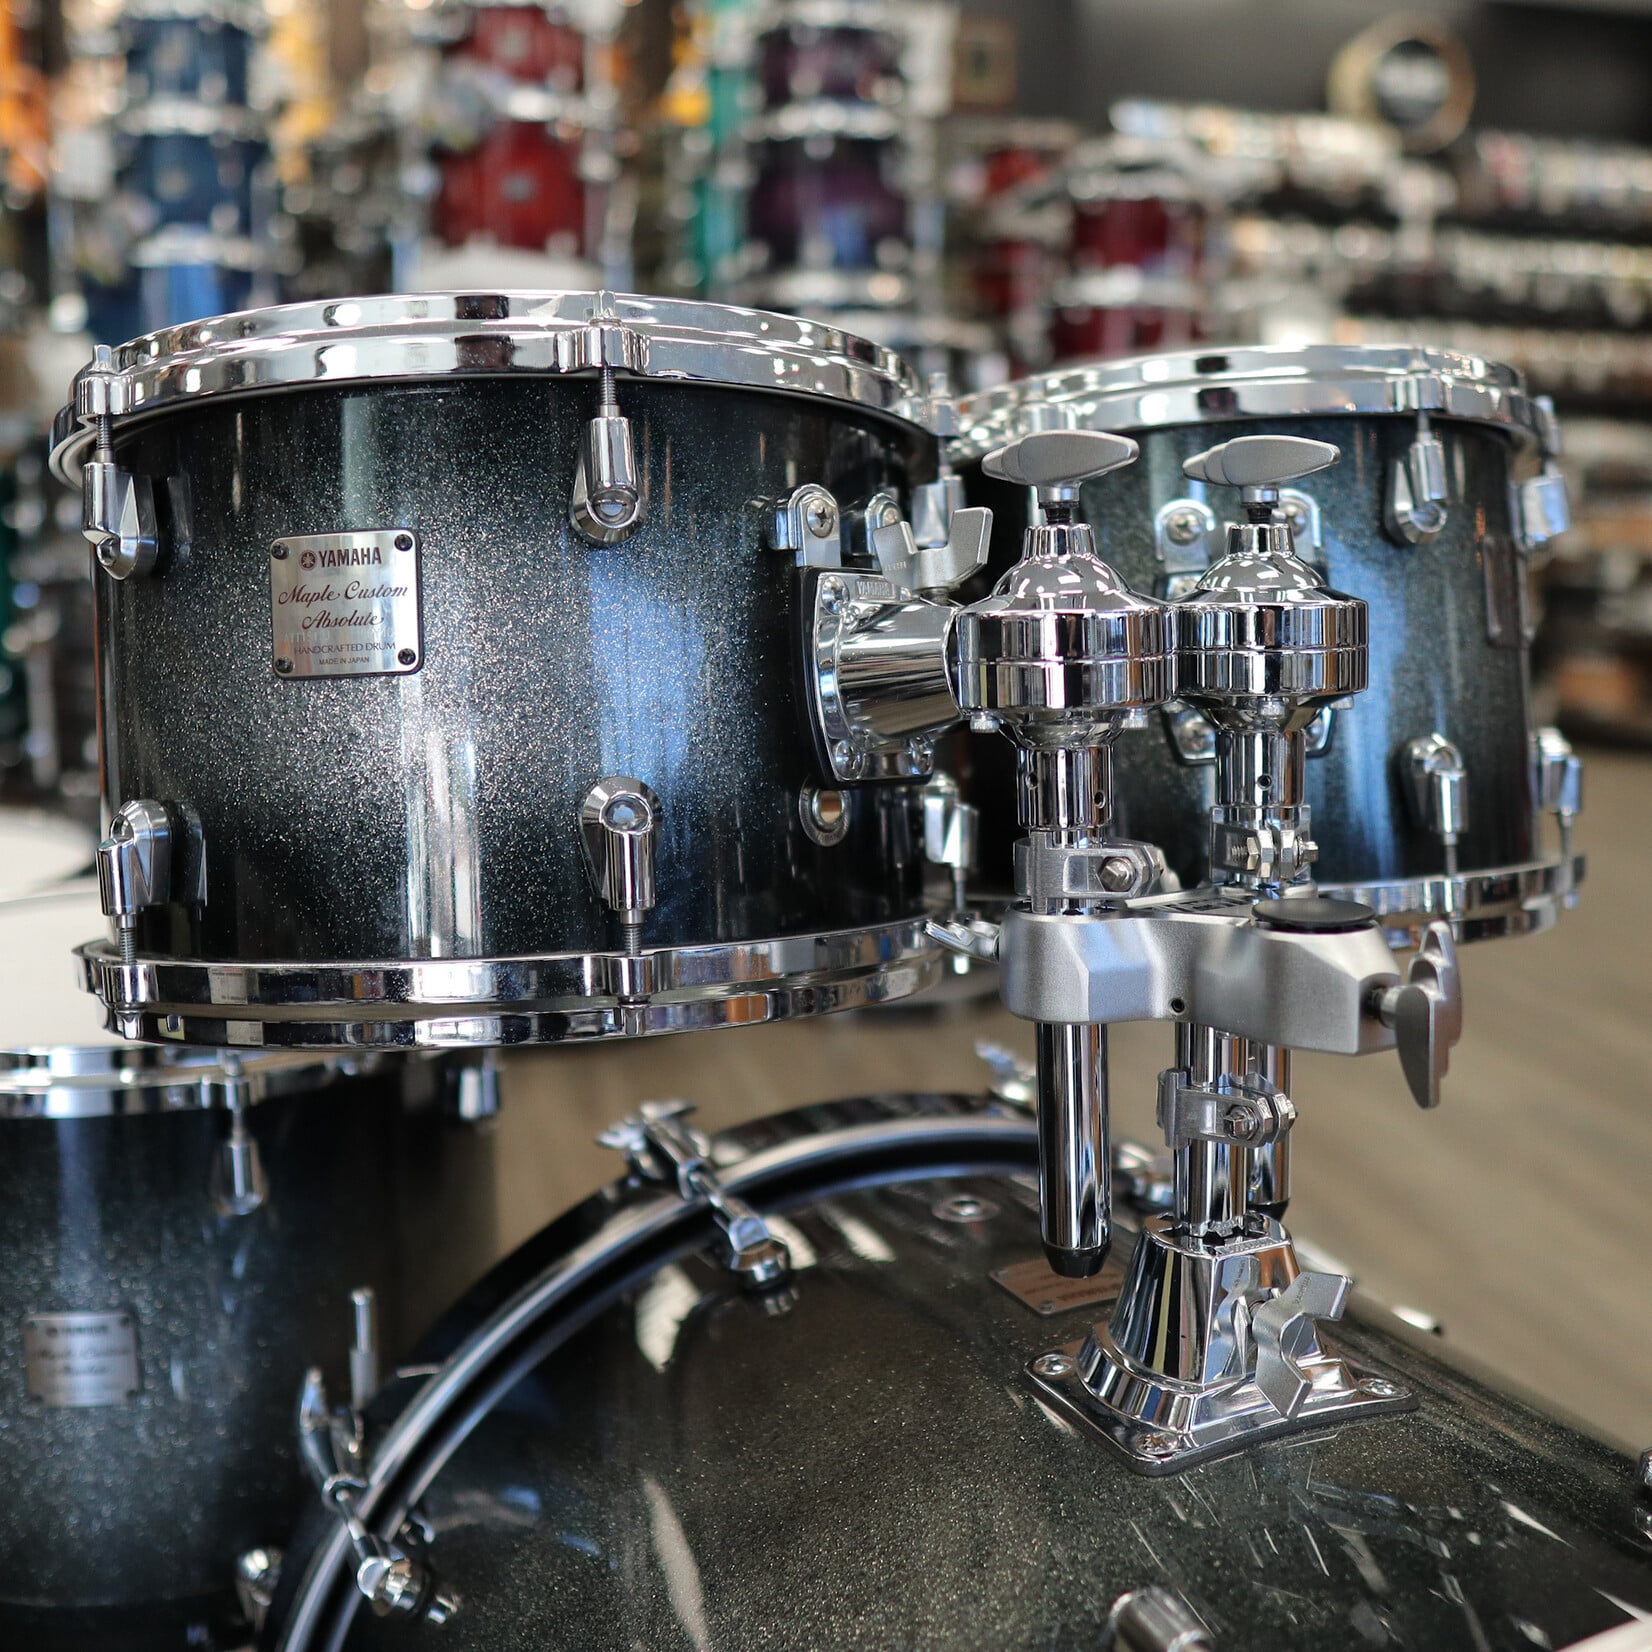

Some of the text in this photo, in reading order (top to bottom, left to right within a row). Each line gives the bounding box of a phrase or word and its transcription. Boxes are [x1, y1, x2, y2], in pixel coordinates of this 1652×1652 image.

[318, 547, 382, 568] YAMAHA
[278, 580, 408, 608] Maple Custom
[301, 610, 385, 630] Absolute
[294, 642, 396, 655] HANDCRAFTED DRUM
[319, 657, 338, 665] MADE
[347, 656, 370, 664] JAPAN
